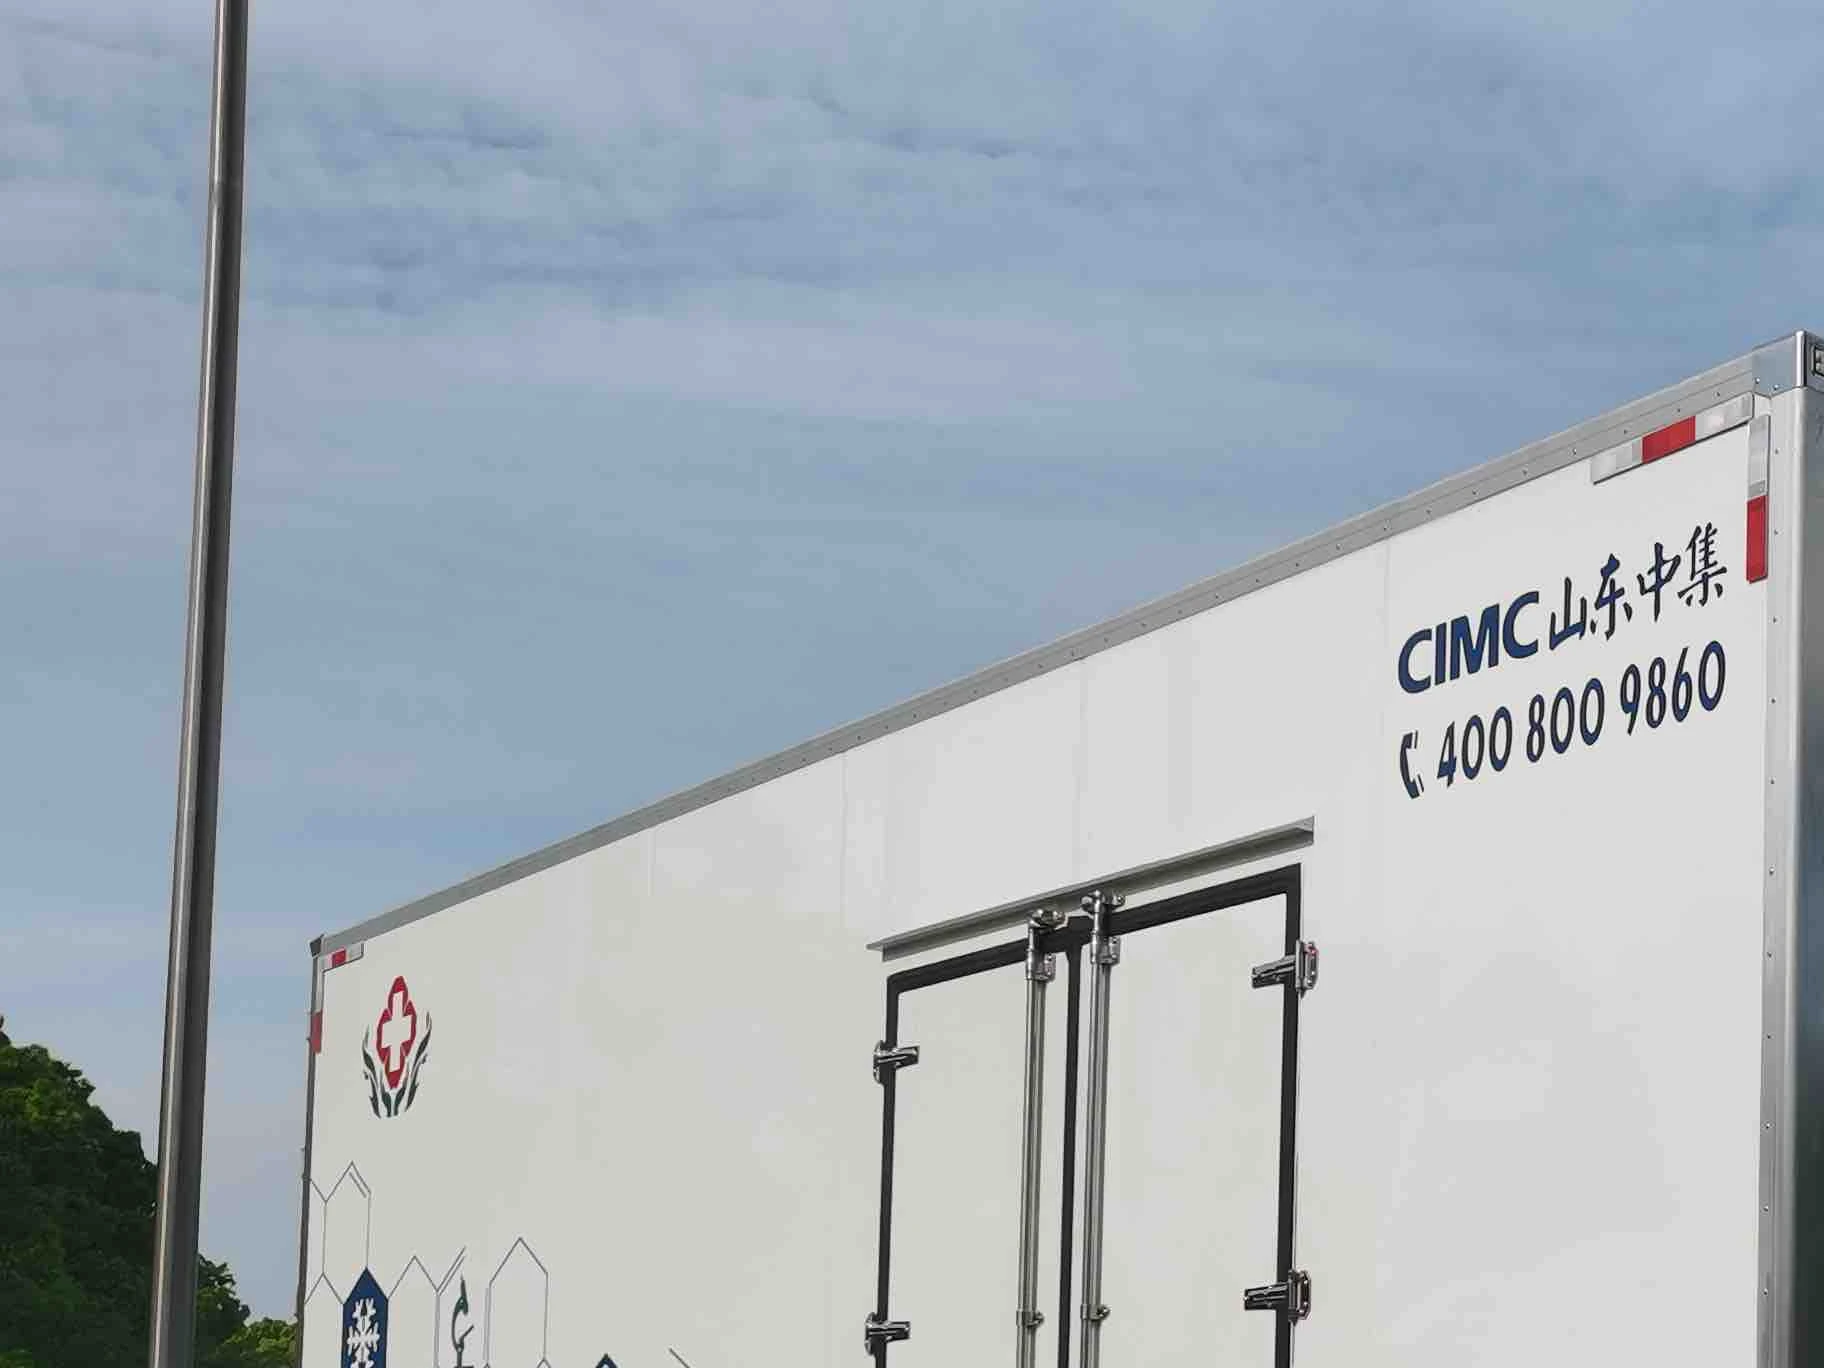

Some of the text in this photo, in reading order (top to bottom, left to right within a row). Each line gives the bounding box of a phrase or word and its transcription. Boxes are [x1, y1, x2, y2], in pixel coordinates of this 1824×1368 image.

[1398, 522, 1728, 694] CIMC 山东中集
[1436, 640, 1726, 788] 400 800 9860
